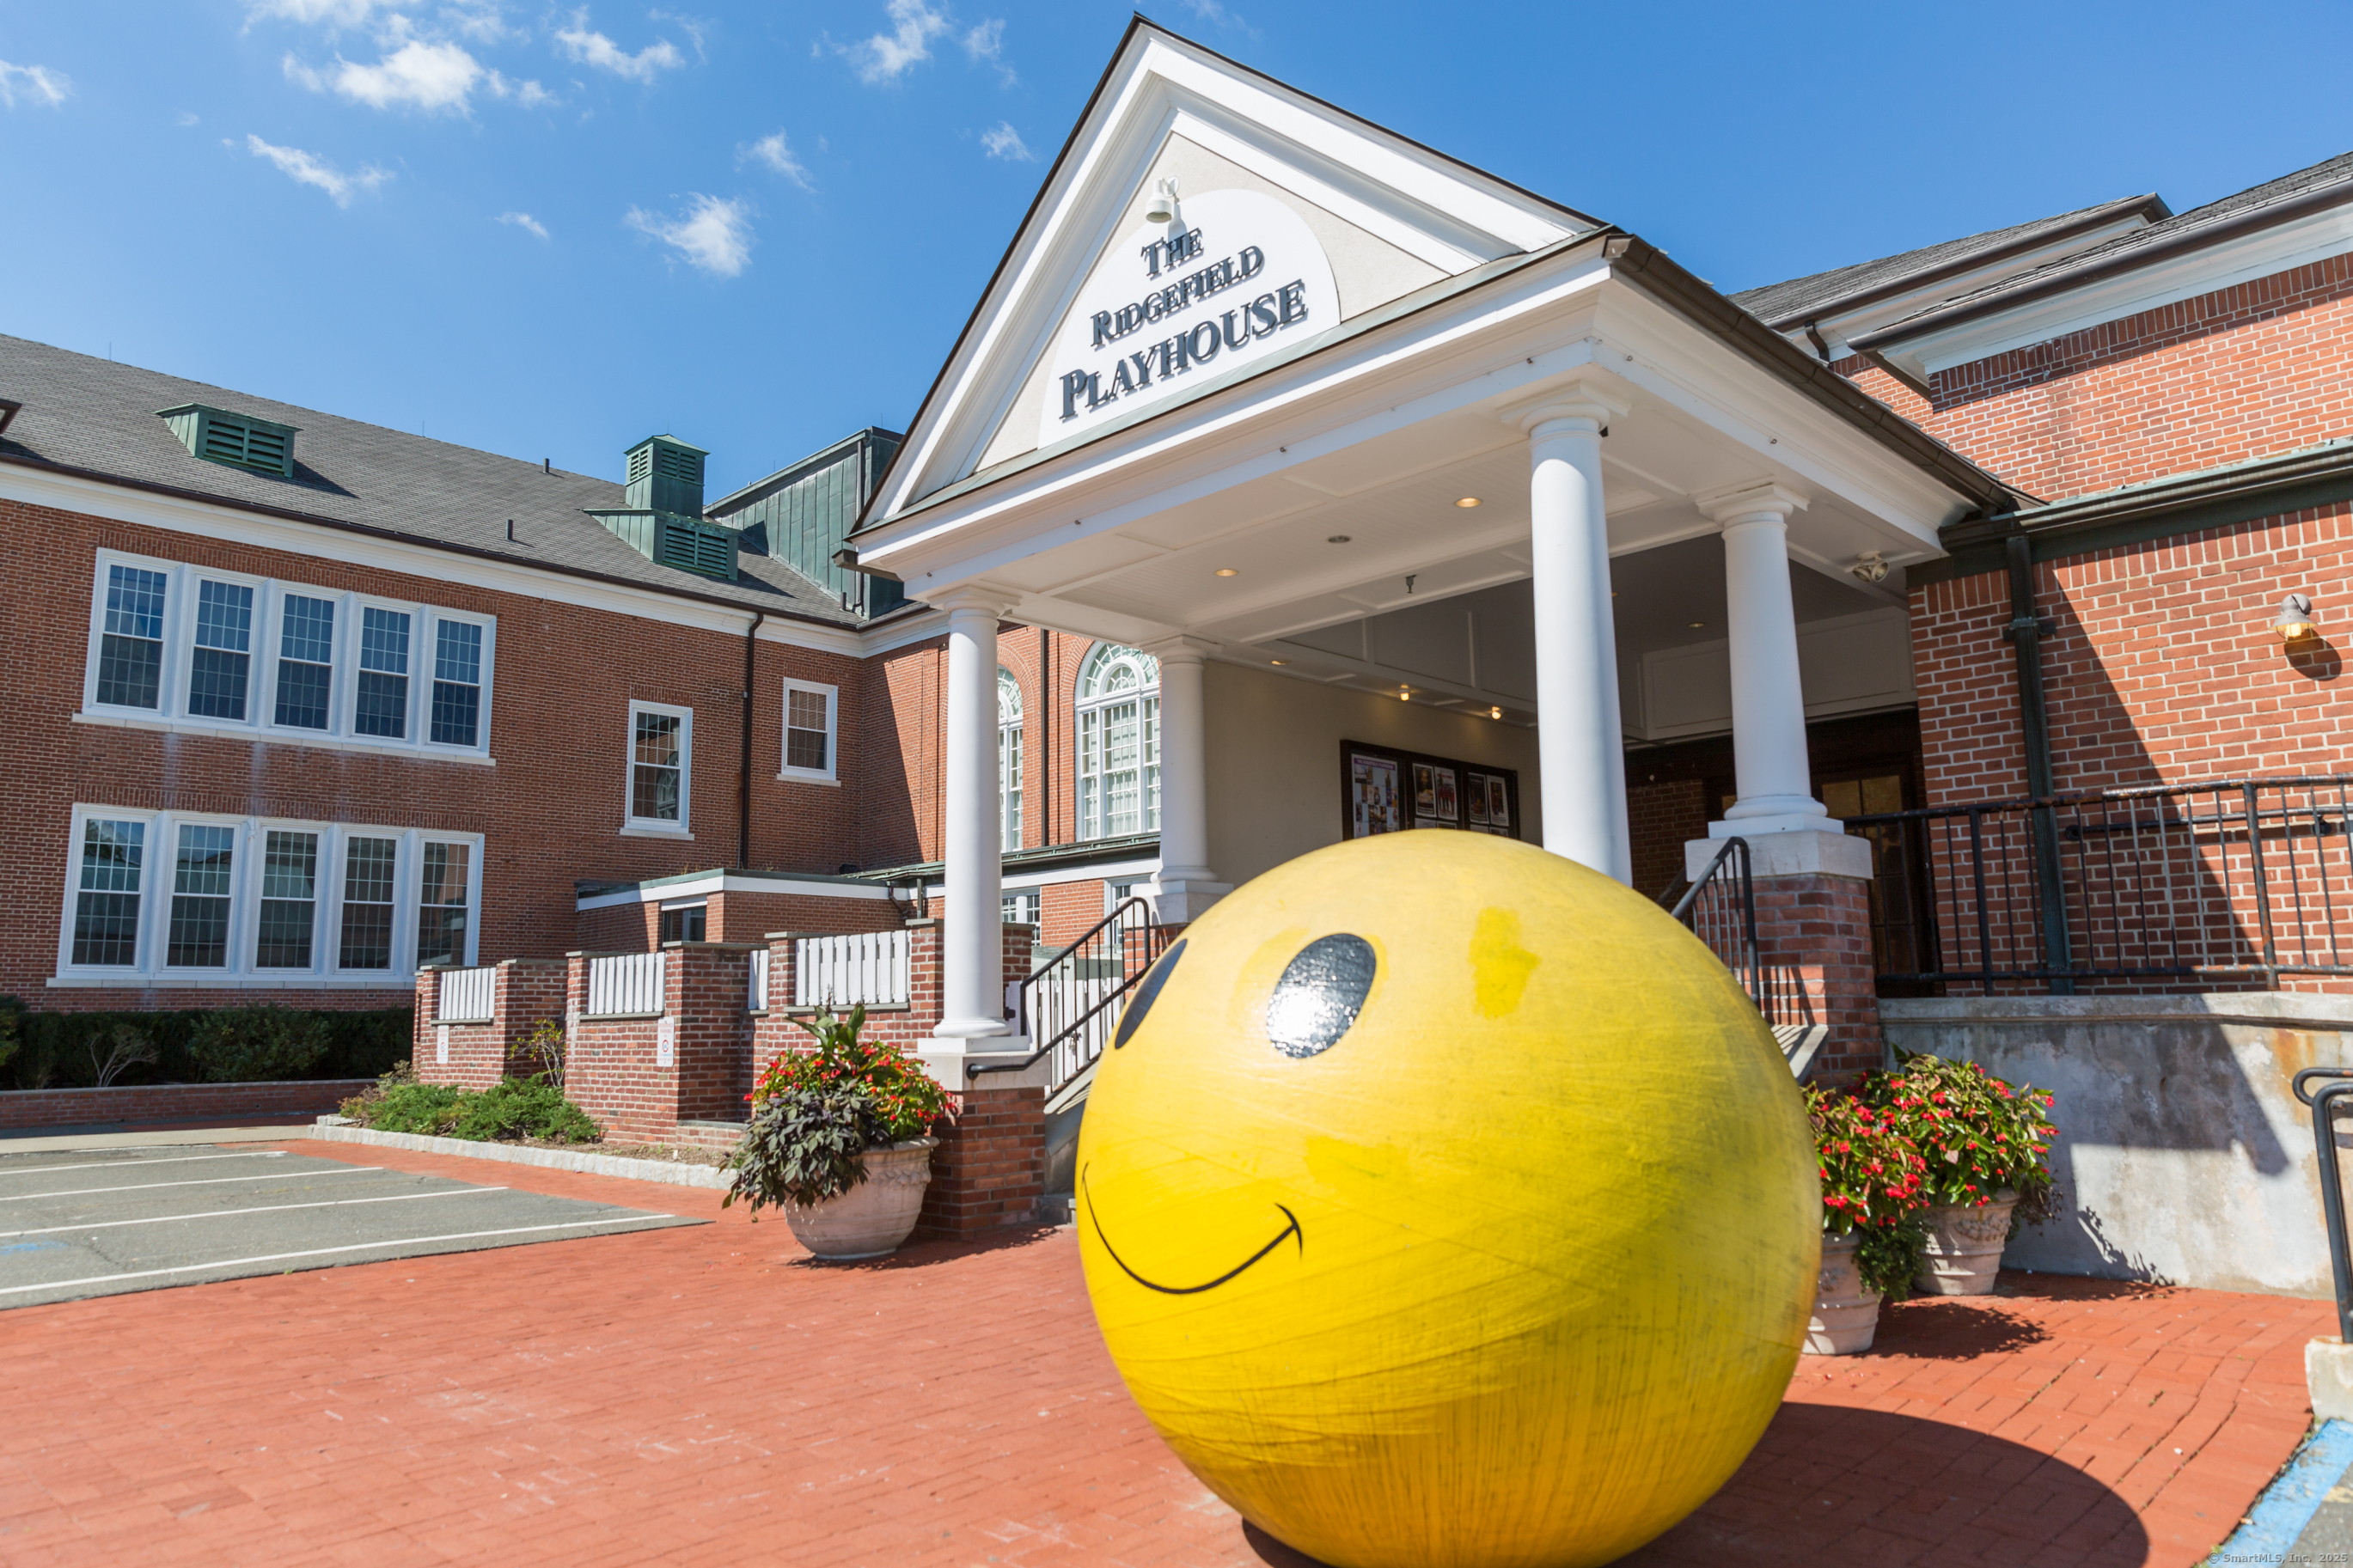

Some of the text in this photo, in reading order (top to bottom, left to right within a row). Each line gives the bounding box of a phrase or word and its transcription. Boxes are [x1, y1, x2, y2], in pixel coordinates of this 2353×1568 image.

[1091, 246, 1264, 348] RIDGEFIELD
[1140, 228, 1203, 278] THE
[1060, 278, 1308, 420] PLAYHOUSE
